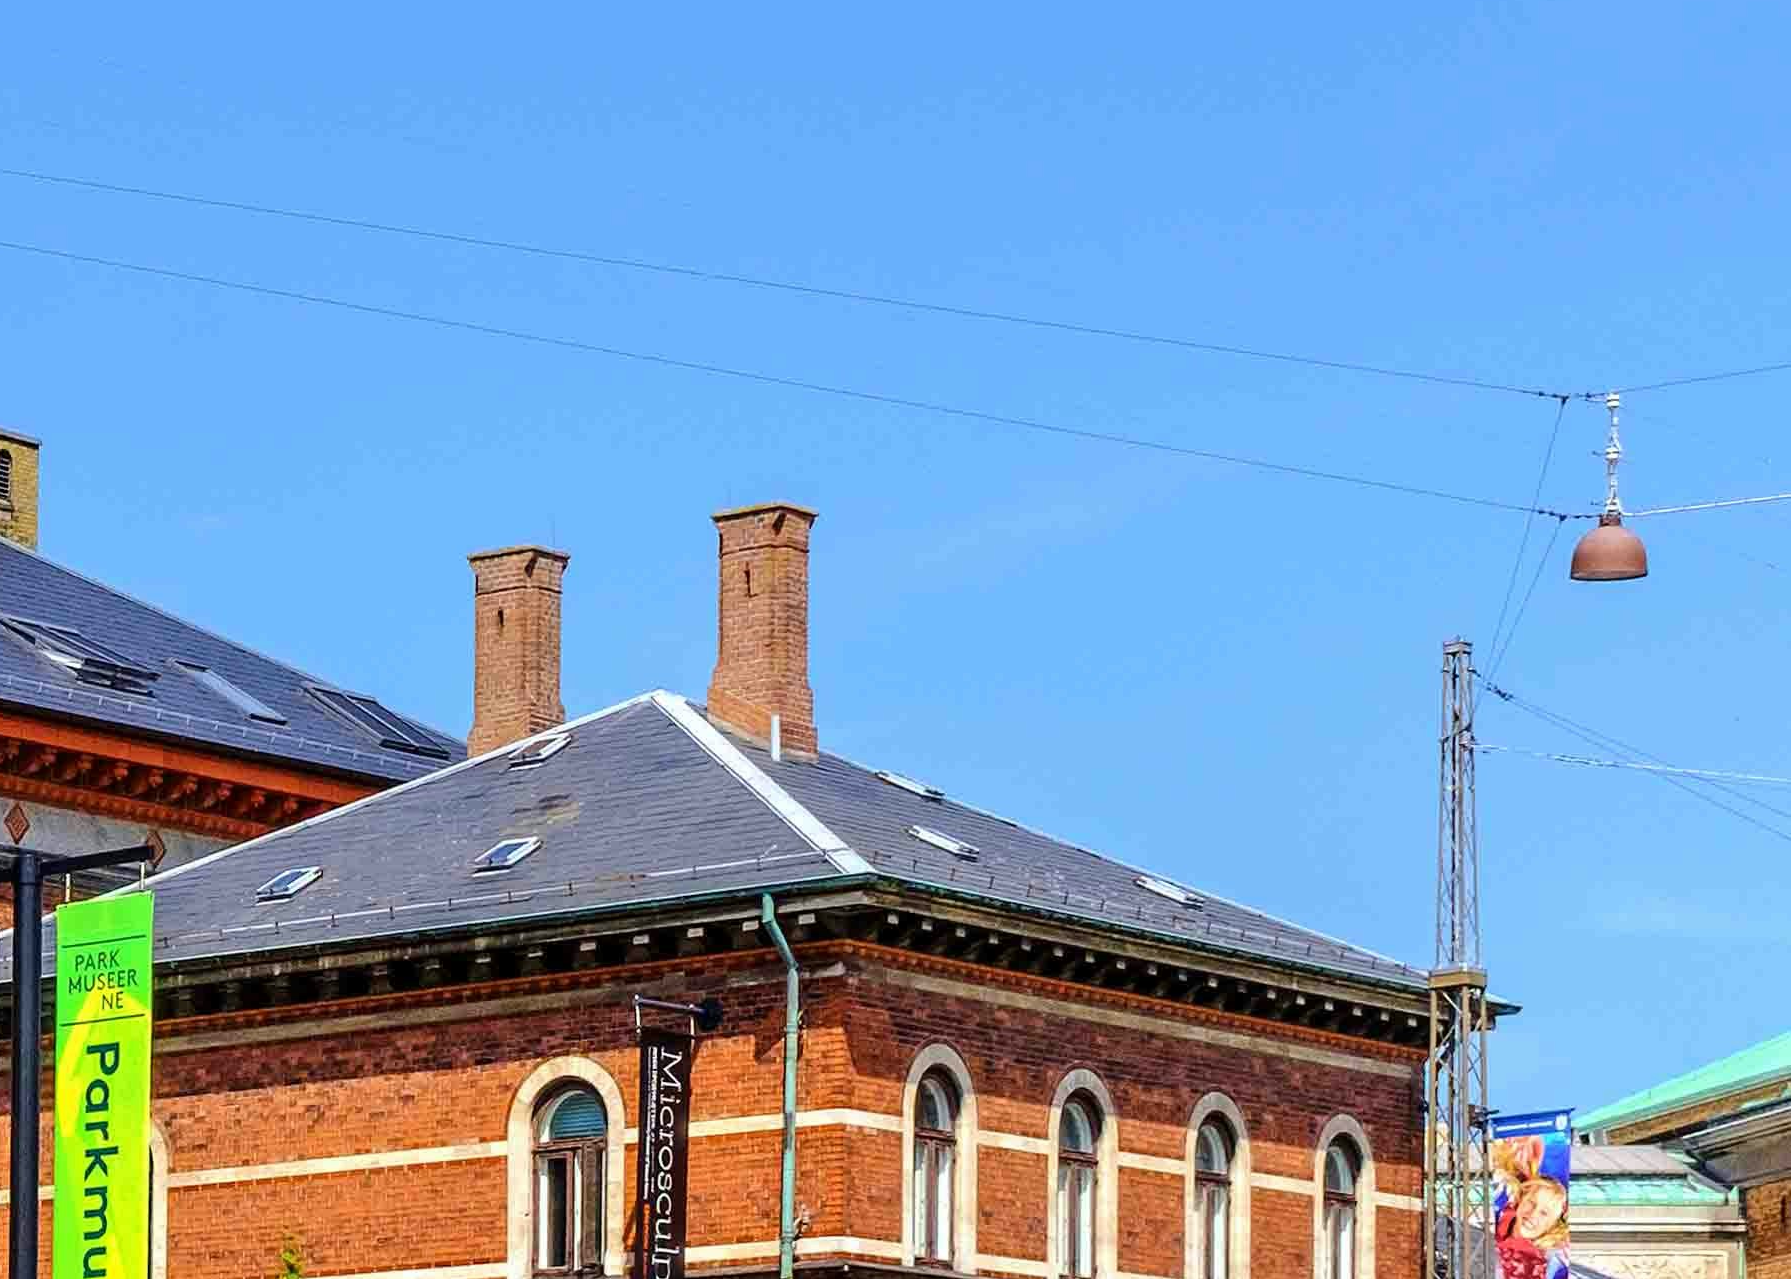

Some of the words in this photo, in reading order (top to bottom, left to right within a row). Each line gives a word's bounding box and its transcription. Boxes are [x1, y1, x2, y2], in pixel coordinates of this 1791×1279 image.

[75, 949, 120, 972] PARK
[68, 969, 138, 994] MUSEER
[102, 991, 124, 1010] NE
